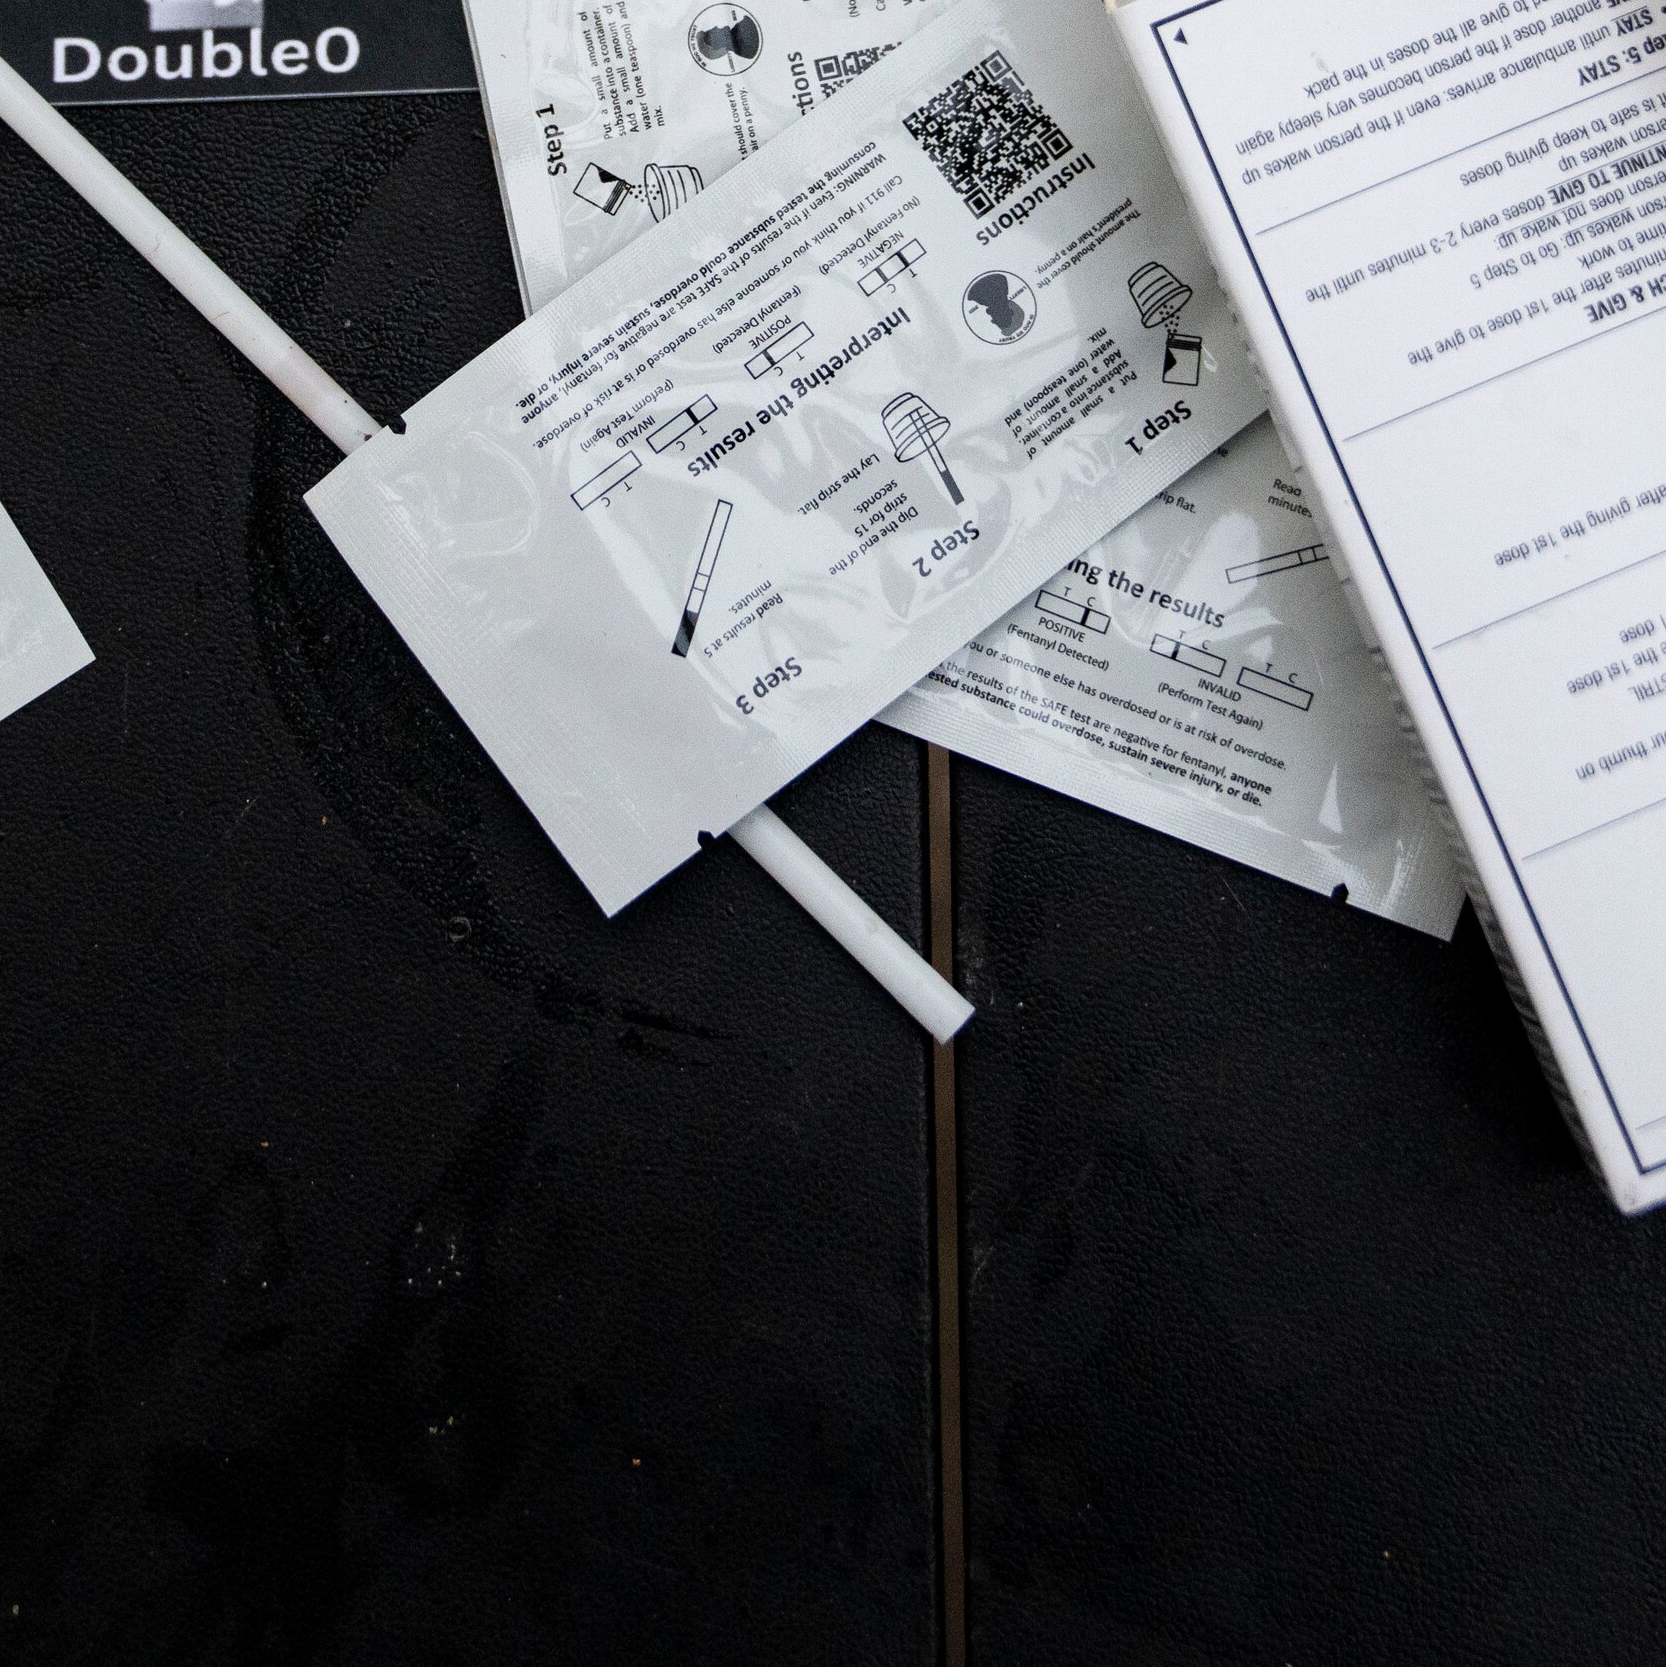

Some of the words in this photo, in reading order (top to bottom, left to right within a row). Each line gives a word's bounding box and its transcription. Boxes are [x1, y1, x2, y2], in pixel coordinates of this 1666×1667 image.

[976, 151, 1097, 246] Instructions
[789, 306, 911, 399] Interpreting
[755, 394, 795, 426] the
[1142, 399, 1193, 441] Step
[687, 420, 757, 477] results
[1124, 436, 1144, 455] 1
